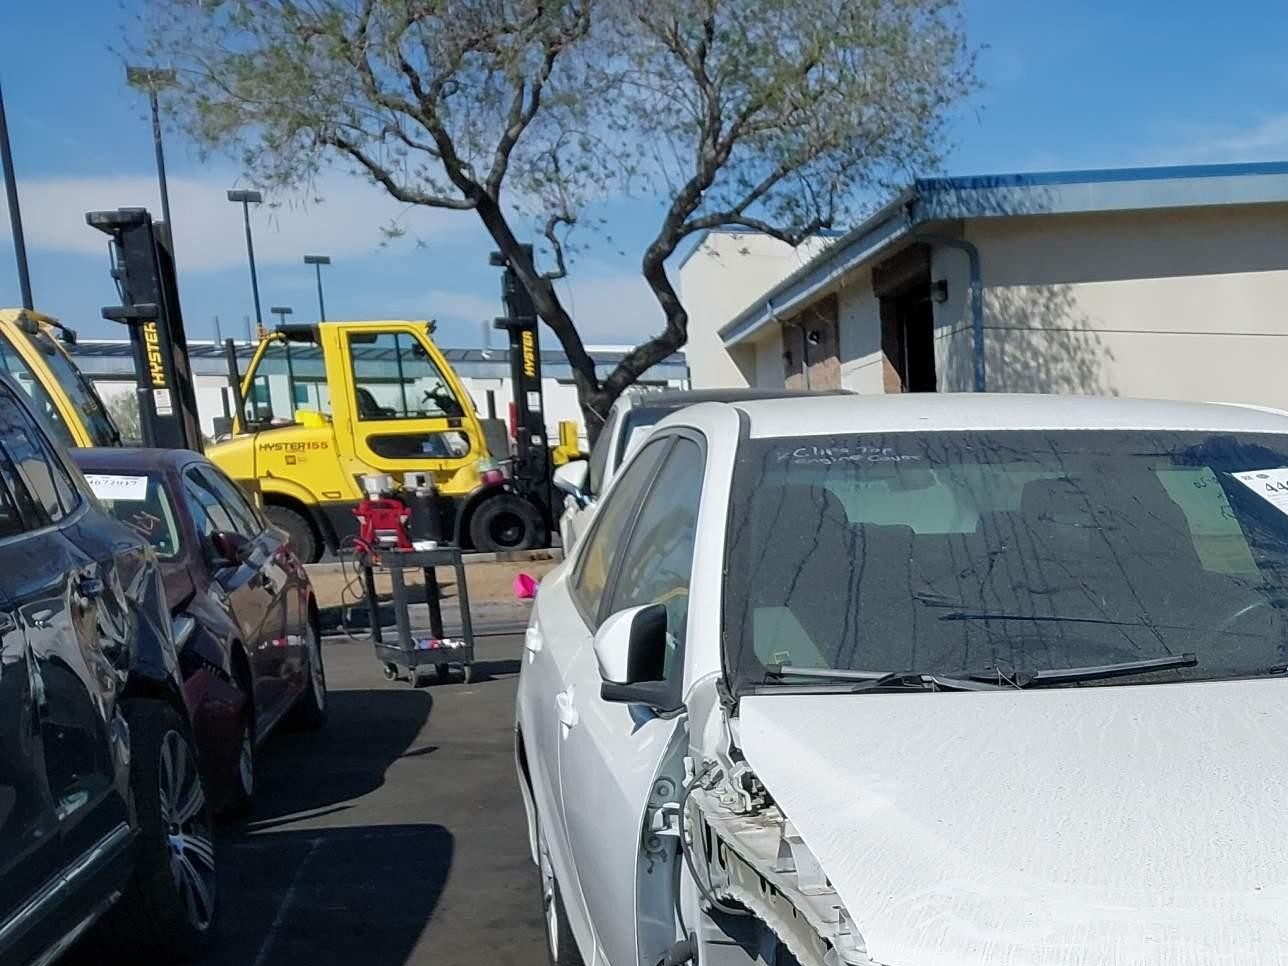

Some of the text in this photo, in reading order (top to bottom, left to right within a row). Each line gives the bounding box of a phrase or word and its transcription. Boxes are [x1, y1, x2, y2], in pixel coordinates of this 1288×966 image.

[144, 322, 165, 385] HYSTER
[522, 331, 535, 377] HYSTER
[259, 442, 306, 452] HYSTER
